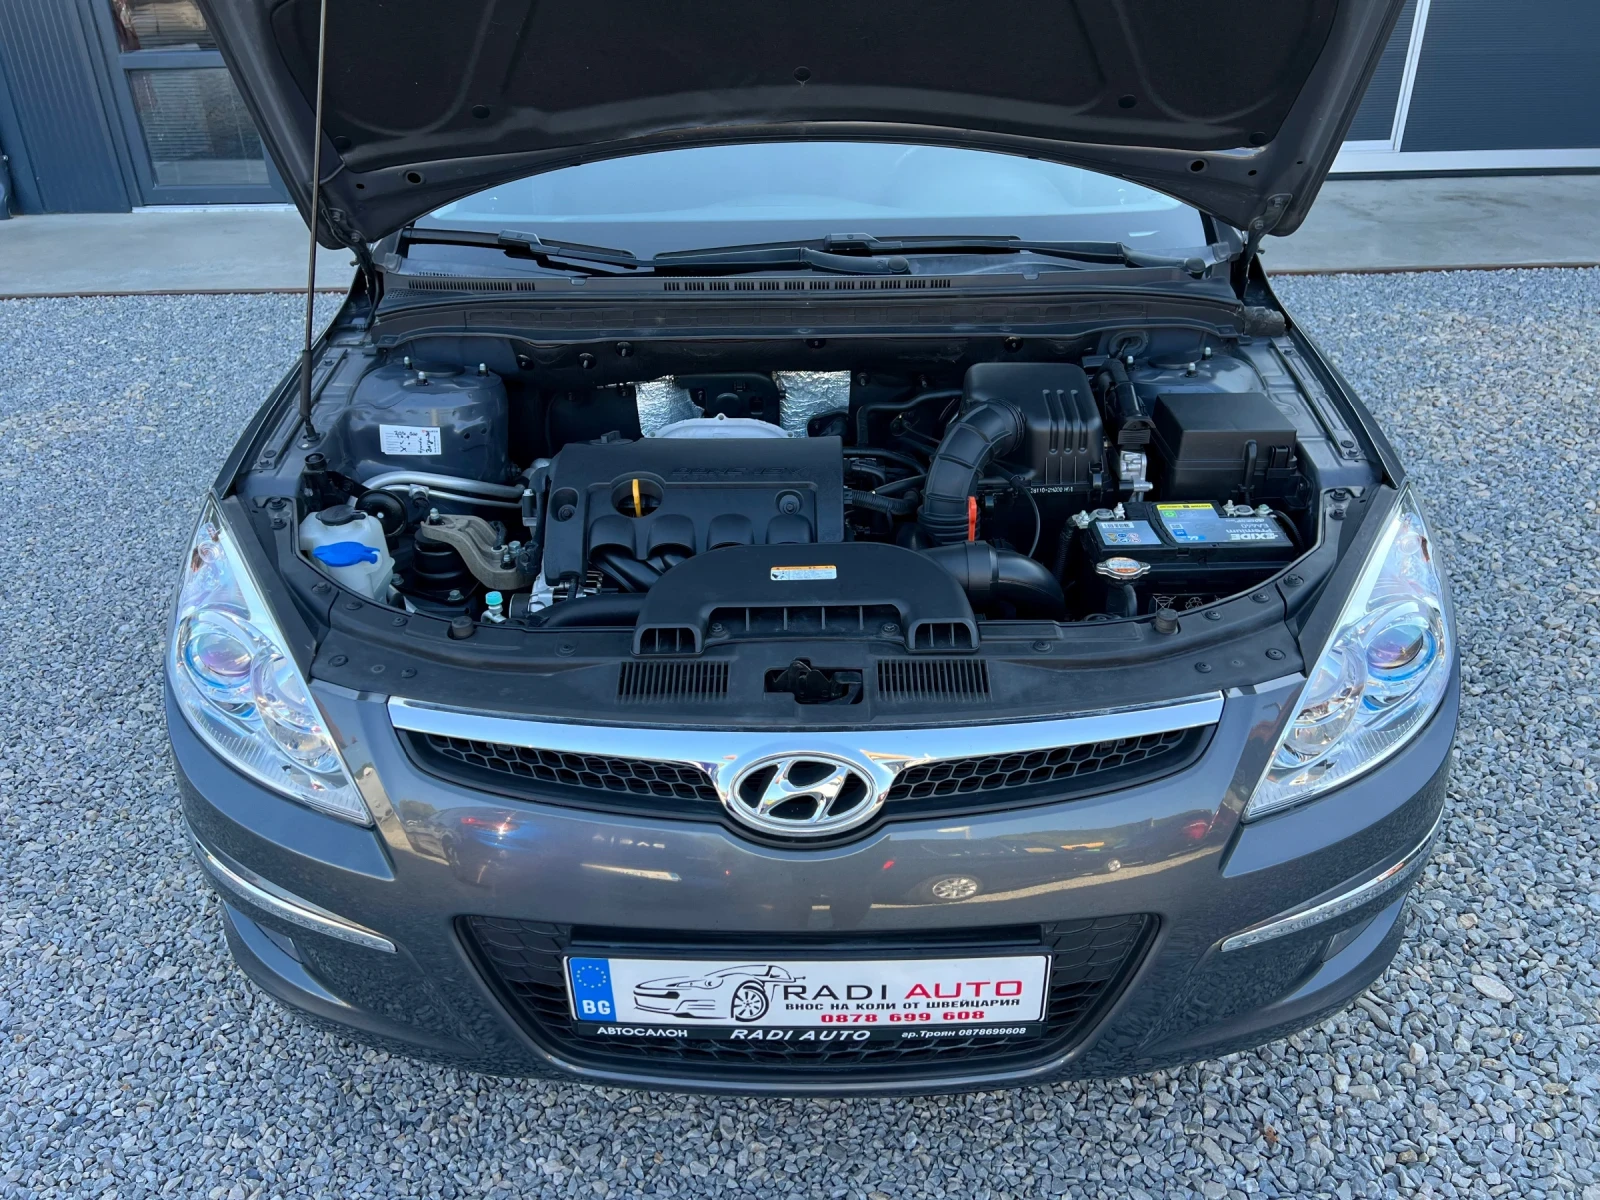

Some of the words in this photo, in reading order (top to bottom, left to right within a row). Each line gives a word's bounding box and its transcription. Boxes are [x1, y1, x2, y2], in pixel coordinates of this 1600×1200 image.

[1230, 532, 1278, 540] EXIDE
[783, 984, 887, 1000] RADI
[904, 980, 1022, 999] AUTO
[582, 999, 611, 1015] BG
[856, 1002, 896, 1010] КОЛИ
[903, 1001, 920, 1009] ОТ
[926, 998, 1020, 1009] ШВЕЙЦАРИЯ
[821, 1013, 878, 1023] 0878
[889, 1013, 931, 1022] 699
[943, 1010, 985, 1020] 608
[597, 1026, 688, 1038] АВТОСАЛОН
[730, 1029, 794, 1040] RADI
[799, 1030, 871, 1041] AUTO
[958, 1027, 1027, 1037] 0878699608
